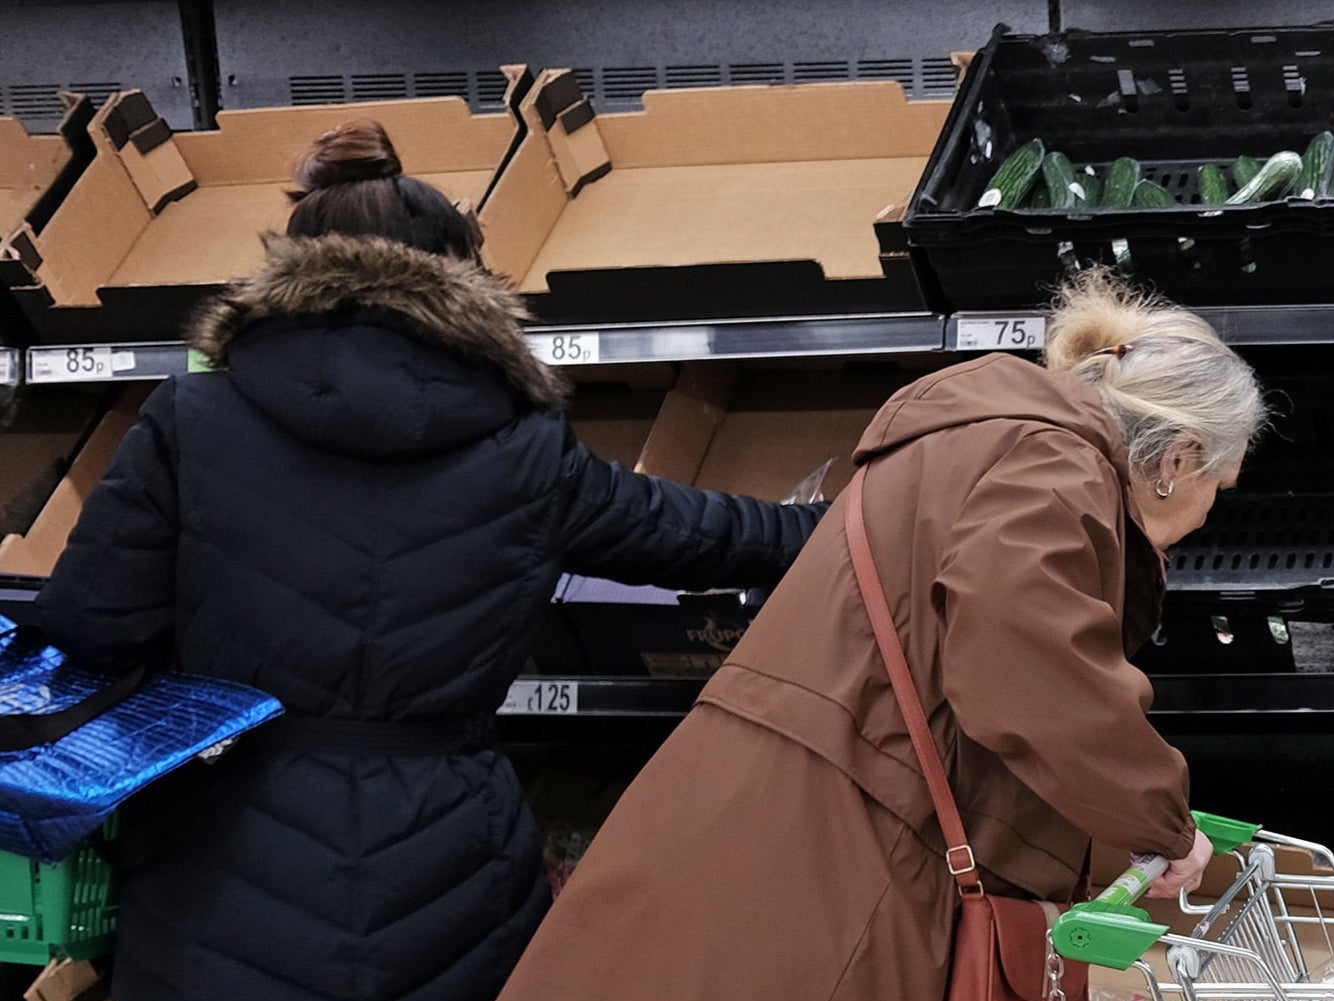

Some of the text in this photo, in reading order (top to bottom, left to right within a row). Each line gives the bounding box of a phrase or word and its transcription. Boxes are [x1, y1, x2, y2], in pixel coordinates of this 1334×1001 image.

[994, 321, 1036, 348] 75p
[66, 348, 104, 373] 85p
[552, 335, 591, 362] 85p
